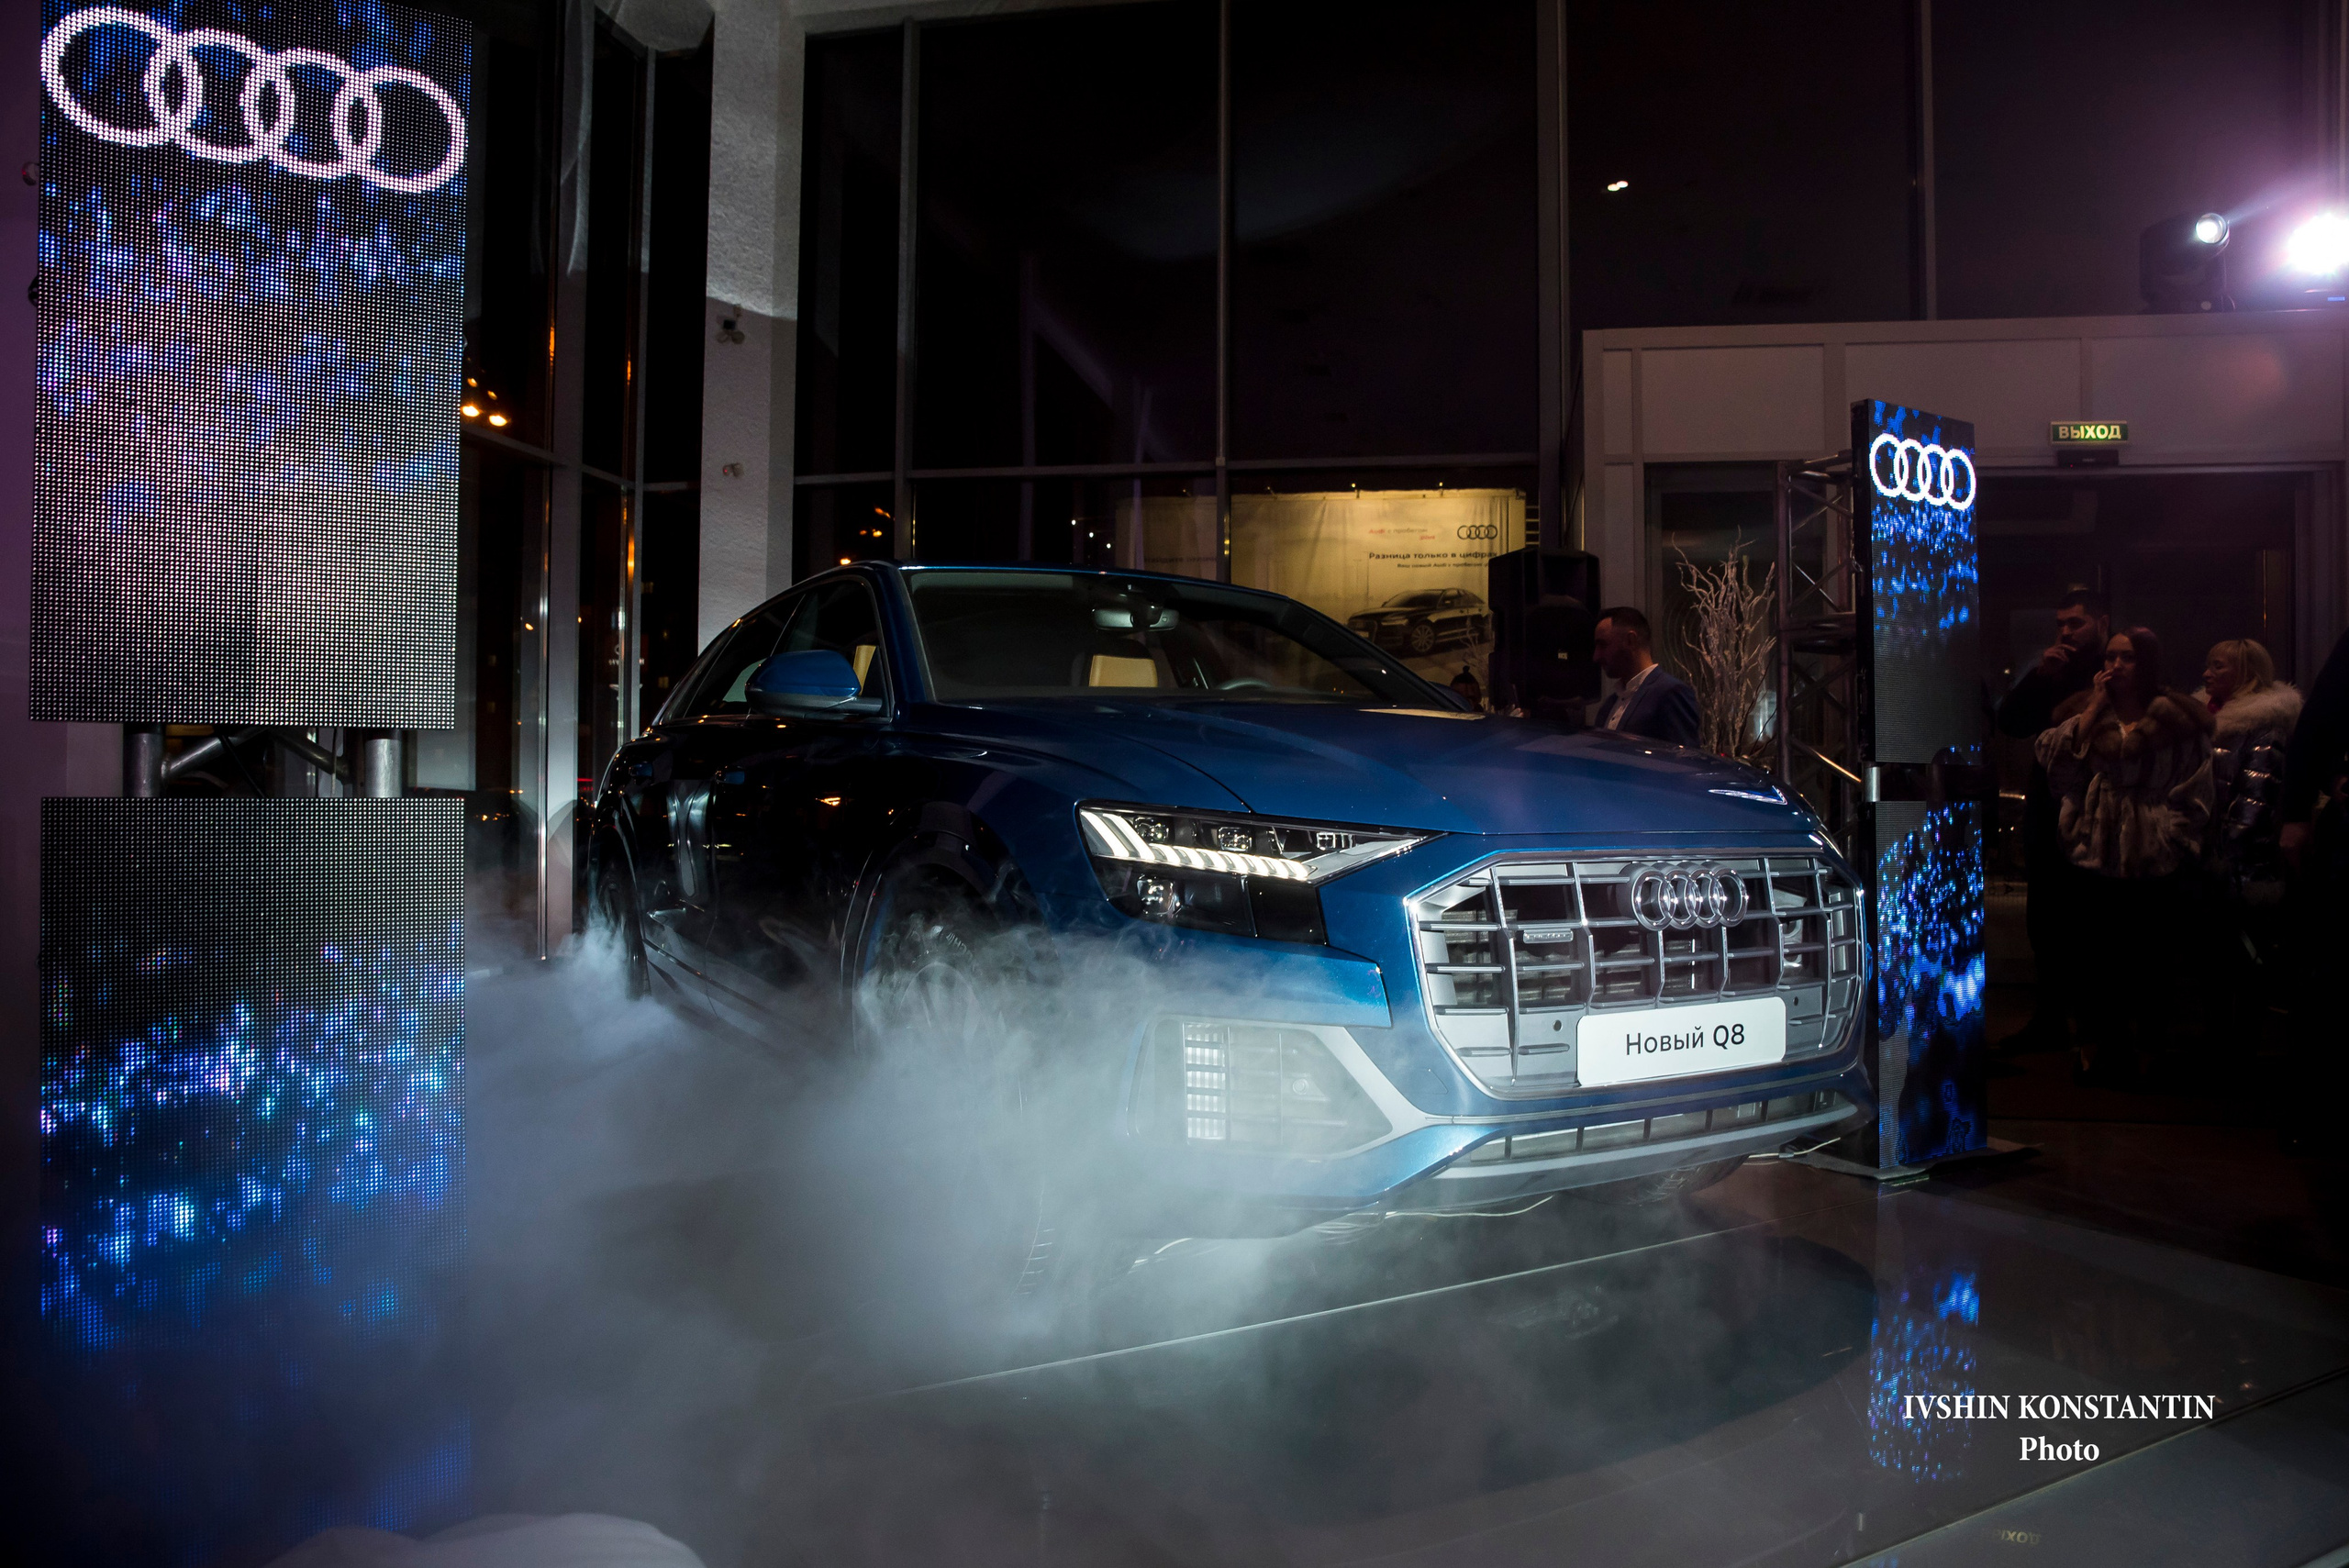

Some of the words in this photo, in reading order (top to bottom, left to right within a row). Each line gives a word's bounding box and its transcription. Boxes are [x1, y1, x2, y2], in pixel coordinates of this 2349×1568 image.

[2058, 425, 2121, 439] ВЫХОД
[1626, 1026, 1704, 1055] Новый
[1713, 1023, 1744, 1051] Q8
